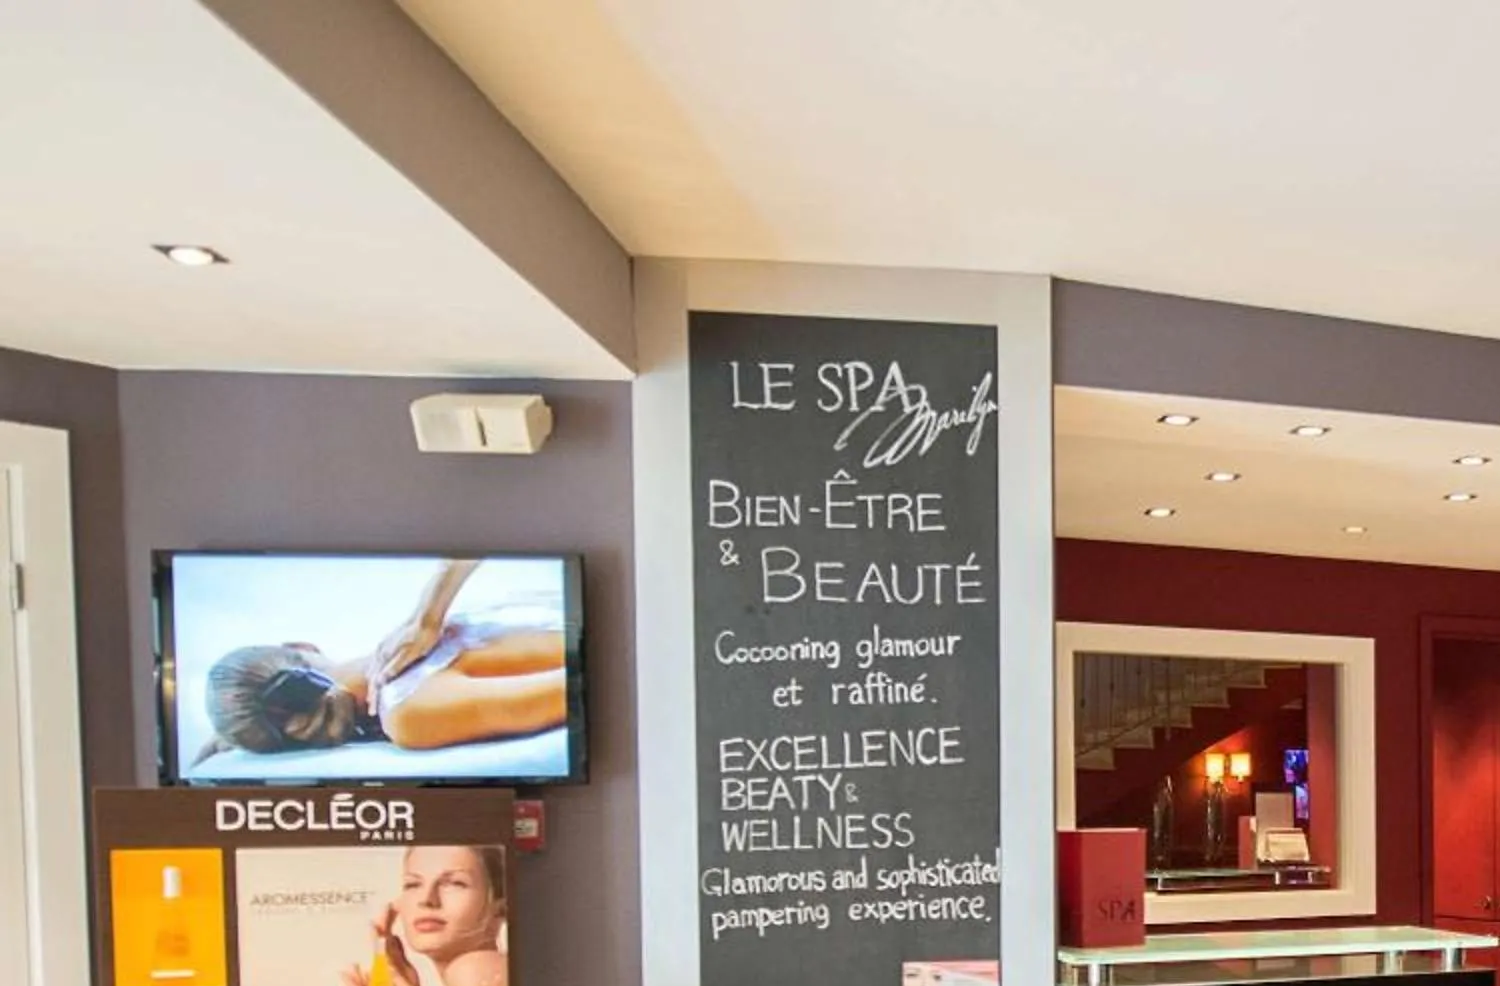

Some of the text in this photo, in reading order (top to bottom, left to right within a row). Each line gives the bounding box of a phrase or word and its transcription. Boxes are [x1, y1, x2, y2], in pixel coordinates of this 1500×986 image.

[729, 360, 912, 413] LE SPA
[719, 539, 987, 605] & BEAUTÉ
[714, 623, 962, 669] Cocooning glamour
[772, 671, 938, 708] et raffiné.
[719, 726, 966, 773] EXCELLENCE
[214, 792, 415, 831] DECLÉOR
[720, 772, 842, 812] BEATY
[359, 830, 415, 841] PARIS
[721, 812, 916, 854] WELLNESS
[701, 866, 828, 898] Glamorous
[831, 855, 869, 890] and
[711, 894, 993, 940] pampering experience.
[1097, 898, 1136, 922] SPA
